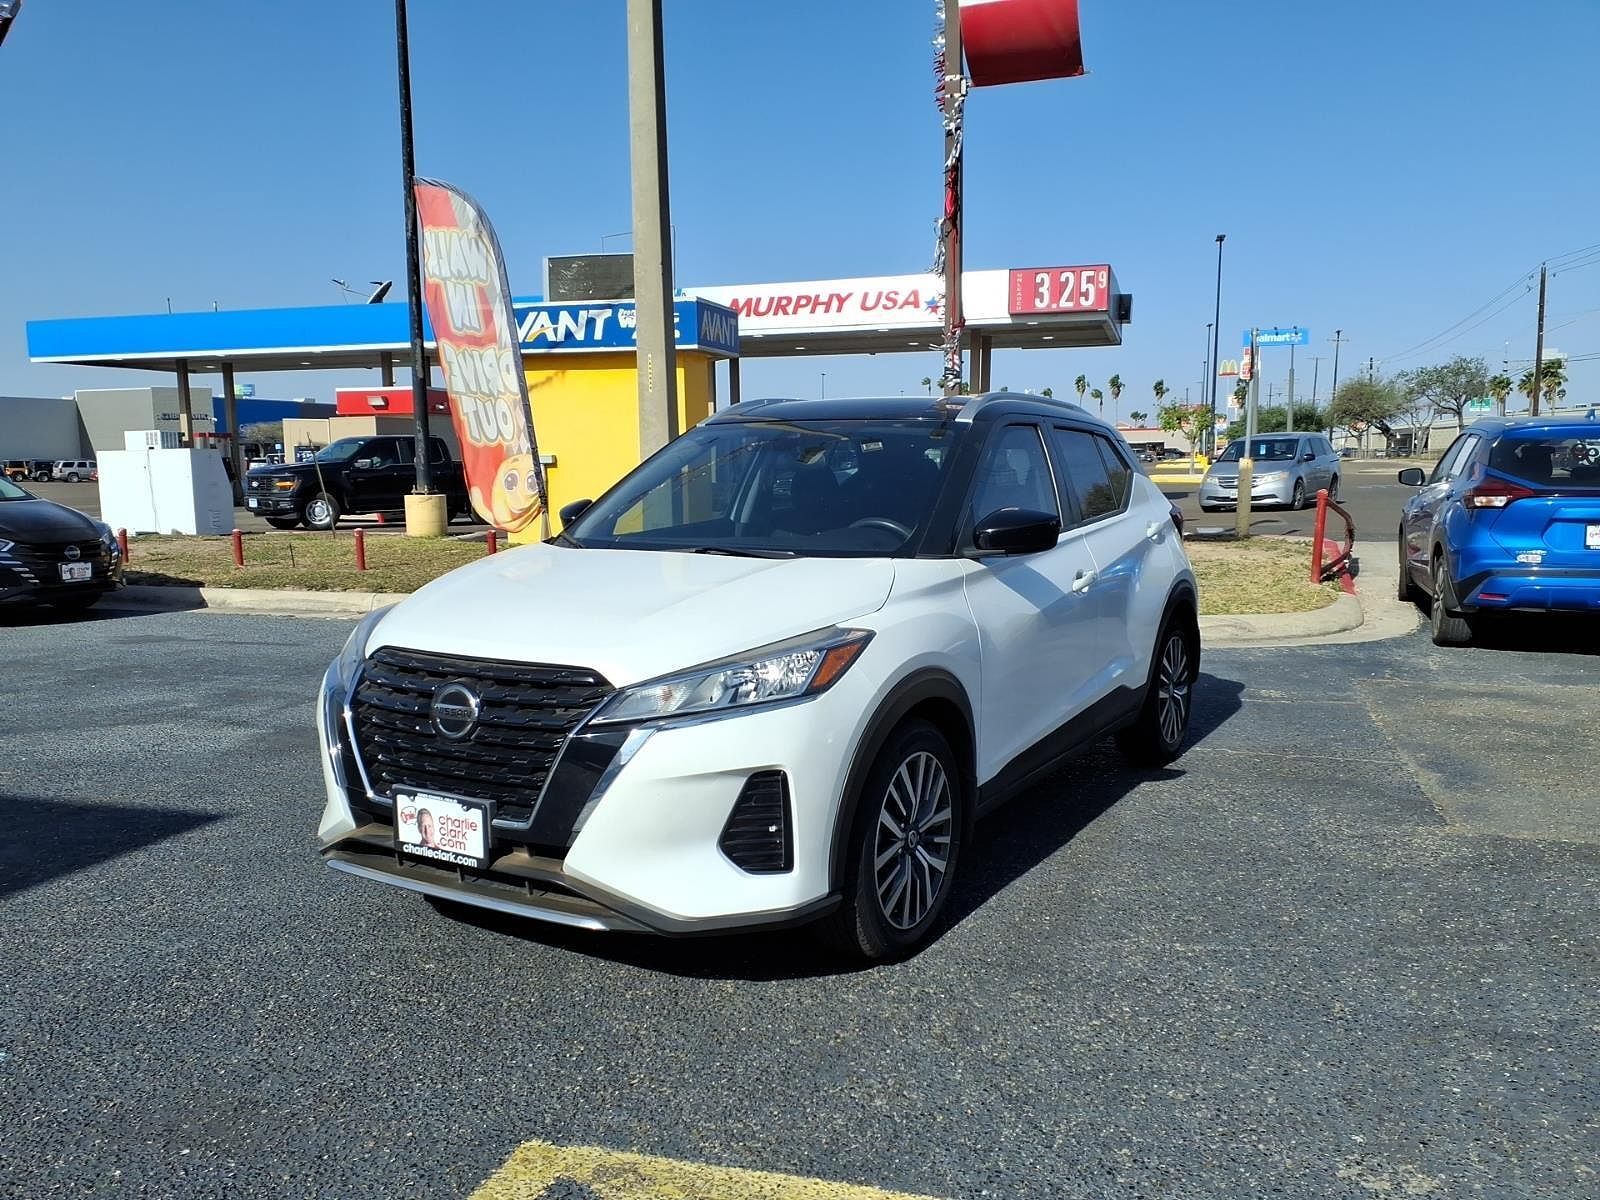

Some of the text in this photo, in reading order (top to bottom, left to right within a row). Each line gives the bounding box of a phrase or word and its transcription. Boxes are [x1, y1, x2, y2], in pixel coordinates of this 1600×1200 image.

[1035, 270, 1096, 309] 3.25
[728, 289, 921, 317] MURPHY USA
[515, 309, 613, 342] VANT
[701, 309, 736, 348] AVANT
[1249, 332, 1291, 344] almart
[438, 814, 478, 831] charlie
[438, 825, 468, 841] clark
[402, 843, 478, 868] charlieclark.com
[437, 837, 467, 851] .com
